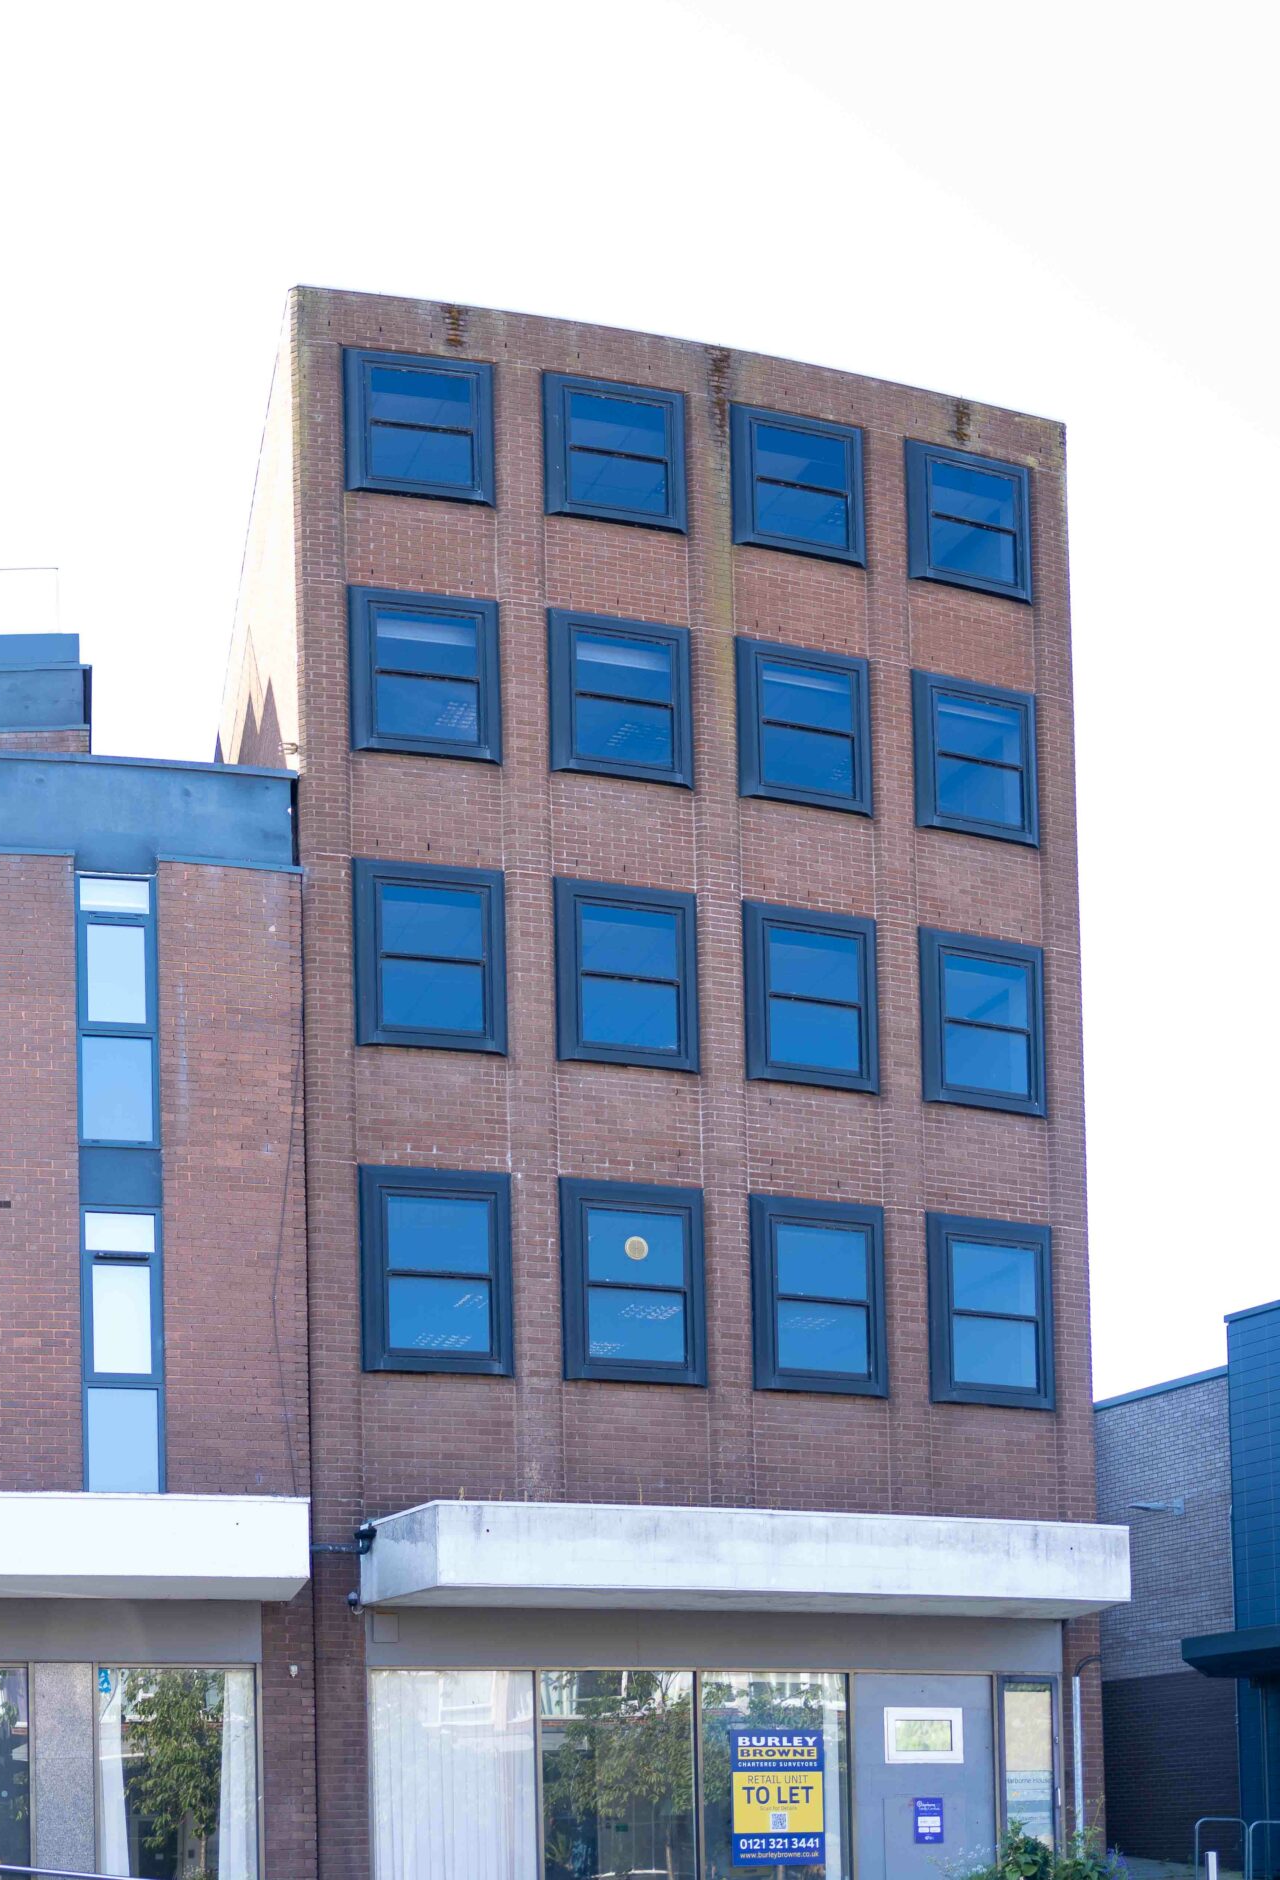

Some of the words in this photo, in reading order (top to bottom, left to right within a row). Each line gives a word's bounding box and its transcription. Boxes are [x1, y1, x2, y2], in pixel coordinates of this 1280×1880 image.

[737, 1736, 817, 1746] BURLEY
[739, 1748, 816, 1758] BROWNE
[747, 1775, 782, 1784] RETAIL
[784, 1774, 809, 1784] UNIT
[742, 1786, 770, 1805] TO
[777, 1785, 814, 1804] LET
[740, 1838, 766, 1849] 0121
[769, 1838, 788, 1849] 321
[791, 1837, 820, 1848] 3441
[740, 1851, 819, 1860] www.burleybrowne.co.uk
